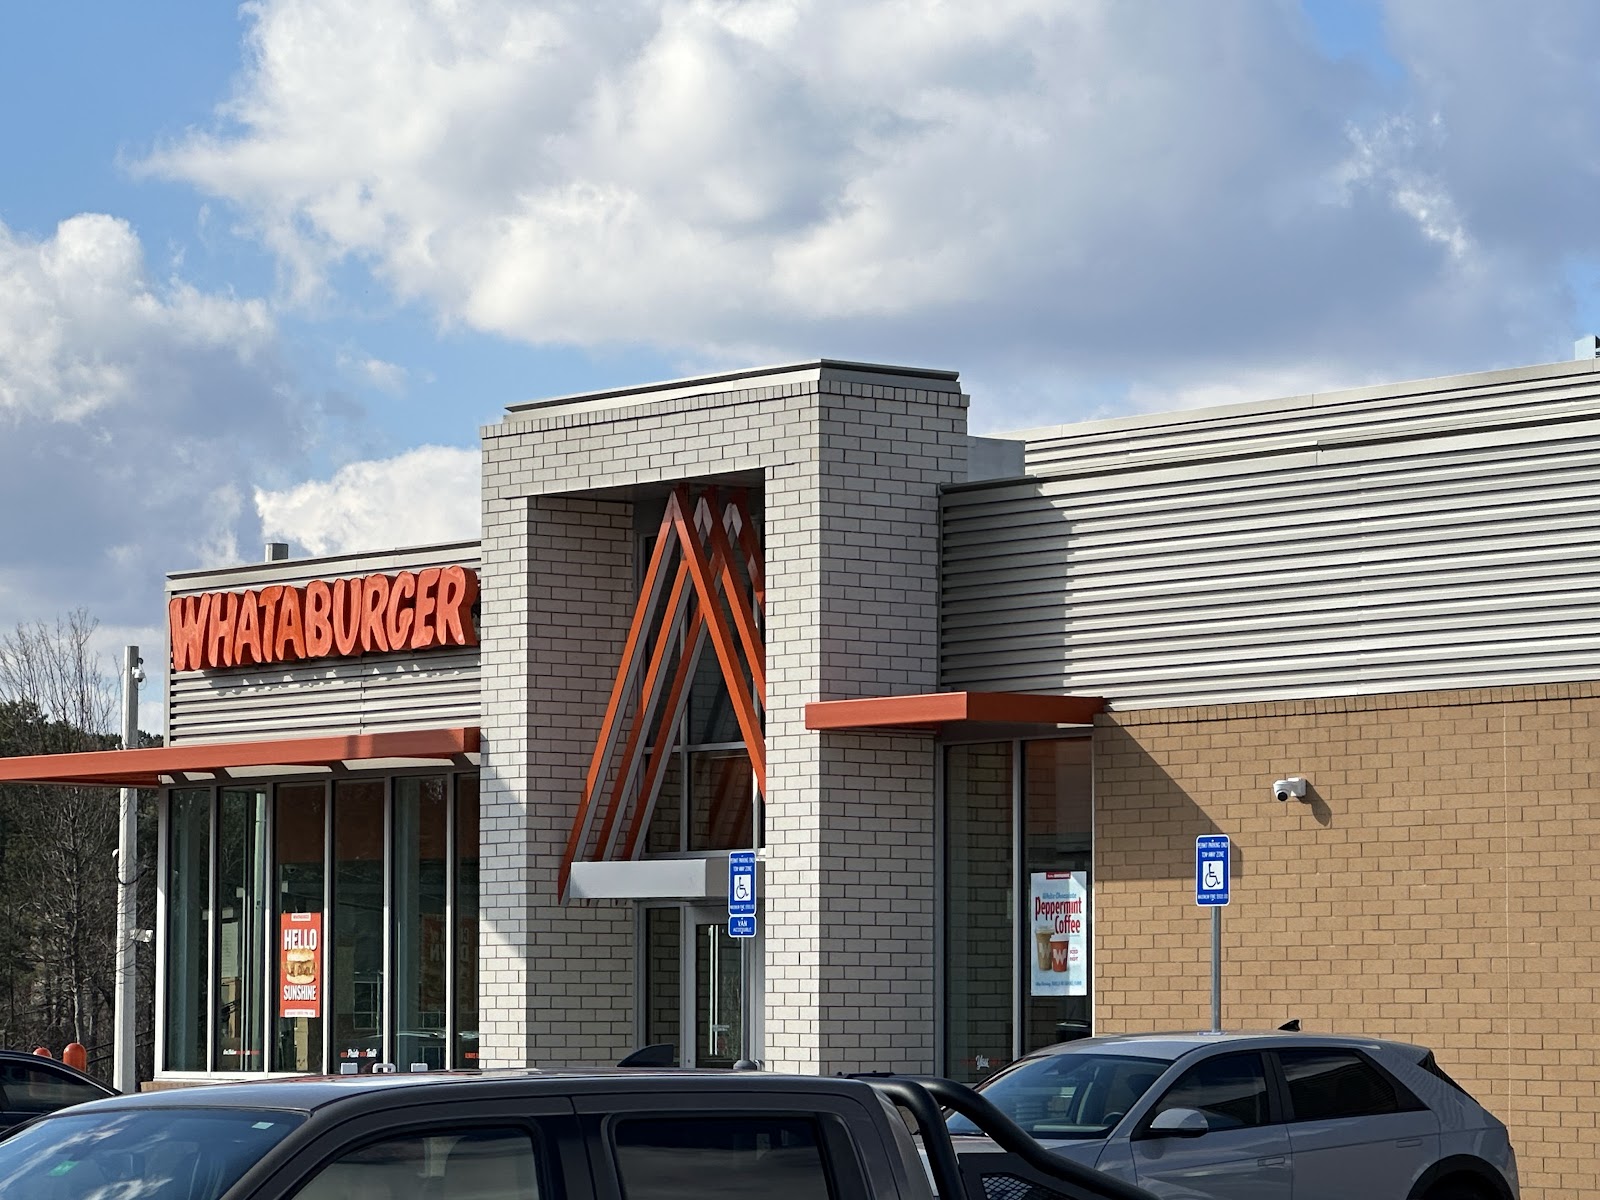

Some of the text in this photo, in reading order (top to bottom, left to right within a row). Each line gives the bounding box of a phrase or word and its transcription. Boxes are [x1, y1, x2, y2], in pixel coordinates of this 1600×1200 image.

[169, 565, 469, 671] WHATABURGER
[1035, 896, 1083, 921] Peppermint
[1054, 914, 1081, 935] Coffee
[283, 928, 317, 951] HELLO
[283, 984, 317, 1001] SUNSHINE
